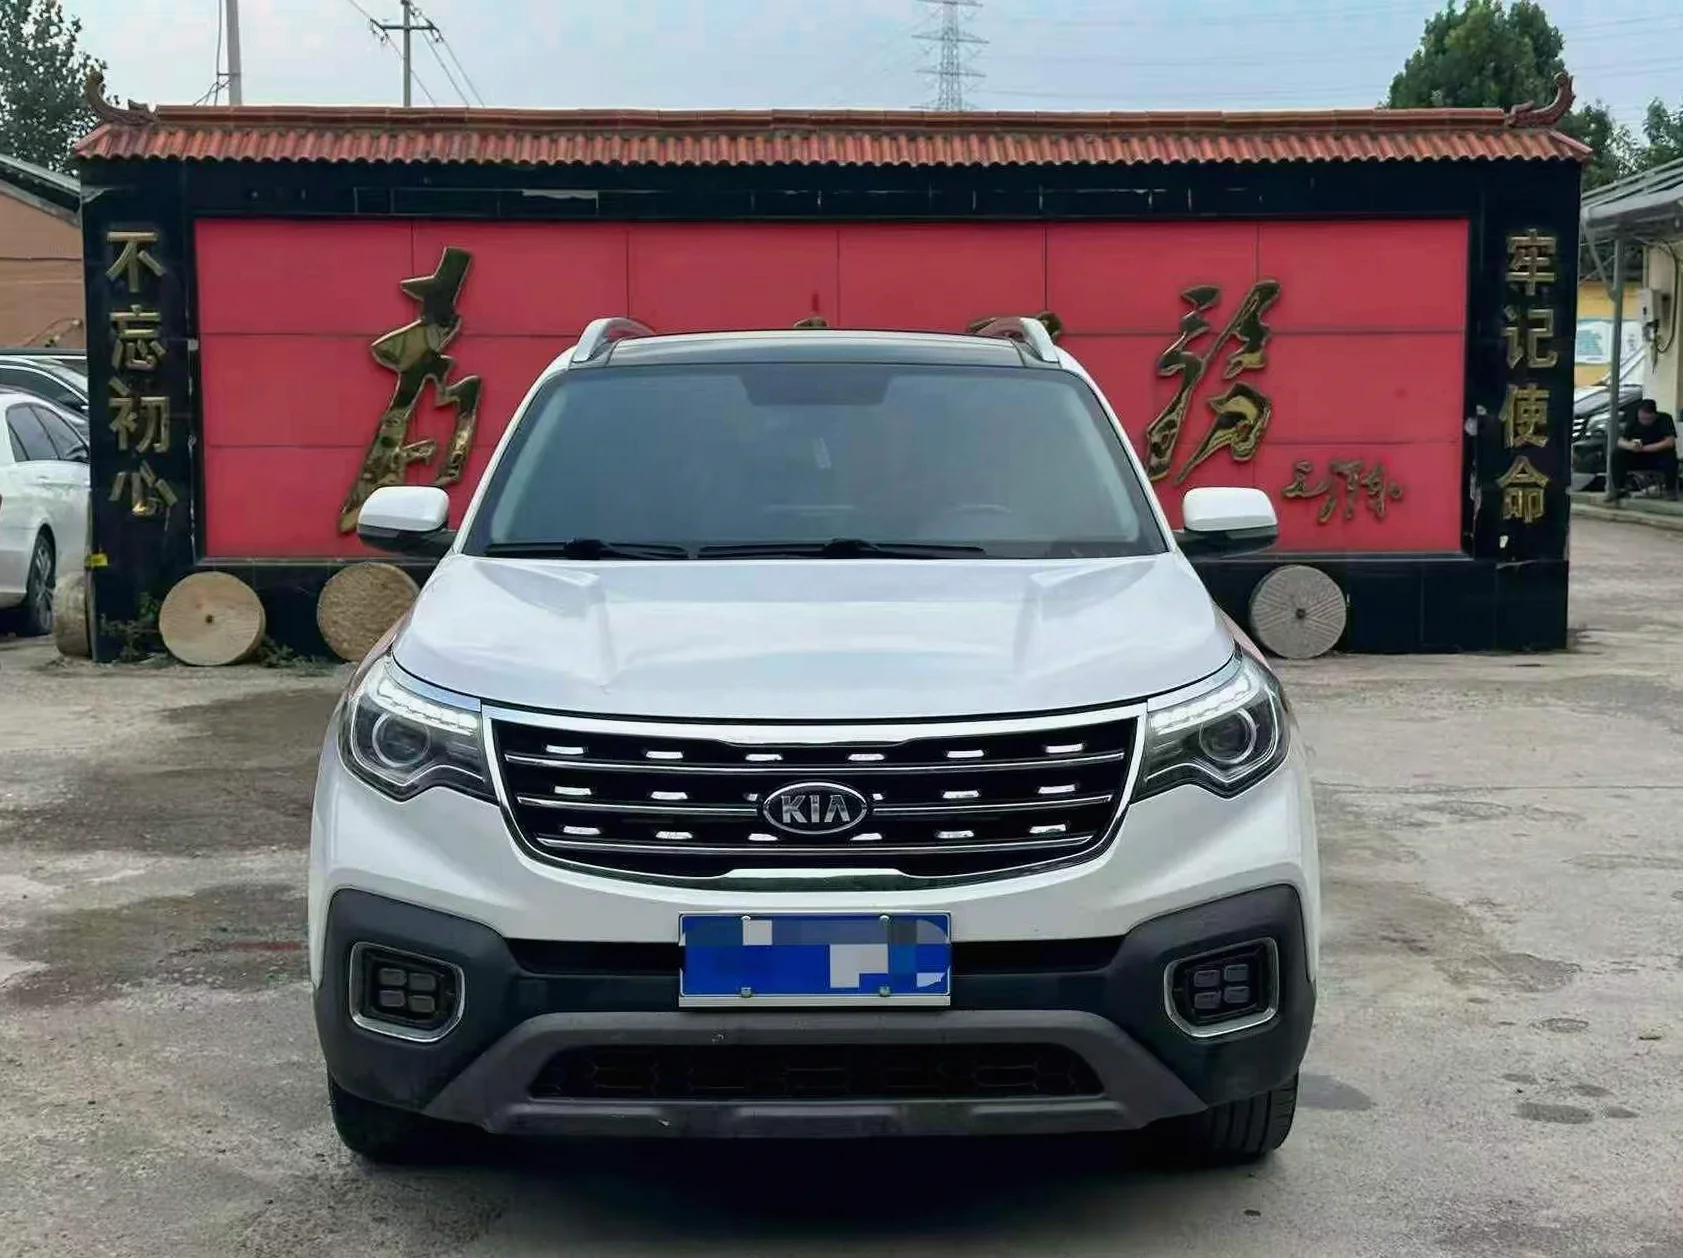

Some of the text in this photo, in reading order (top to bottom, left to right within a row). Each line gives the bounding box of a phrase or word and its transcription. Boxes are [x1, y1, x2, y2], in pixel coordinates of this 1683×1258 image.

[104, 230, 178, 517] 不忘初心
[1496, 227, 1559, 524] 牢记使命
[780, 794, 851, 824] KIA
